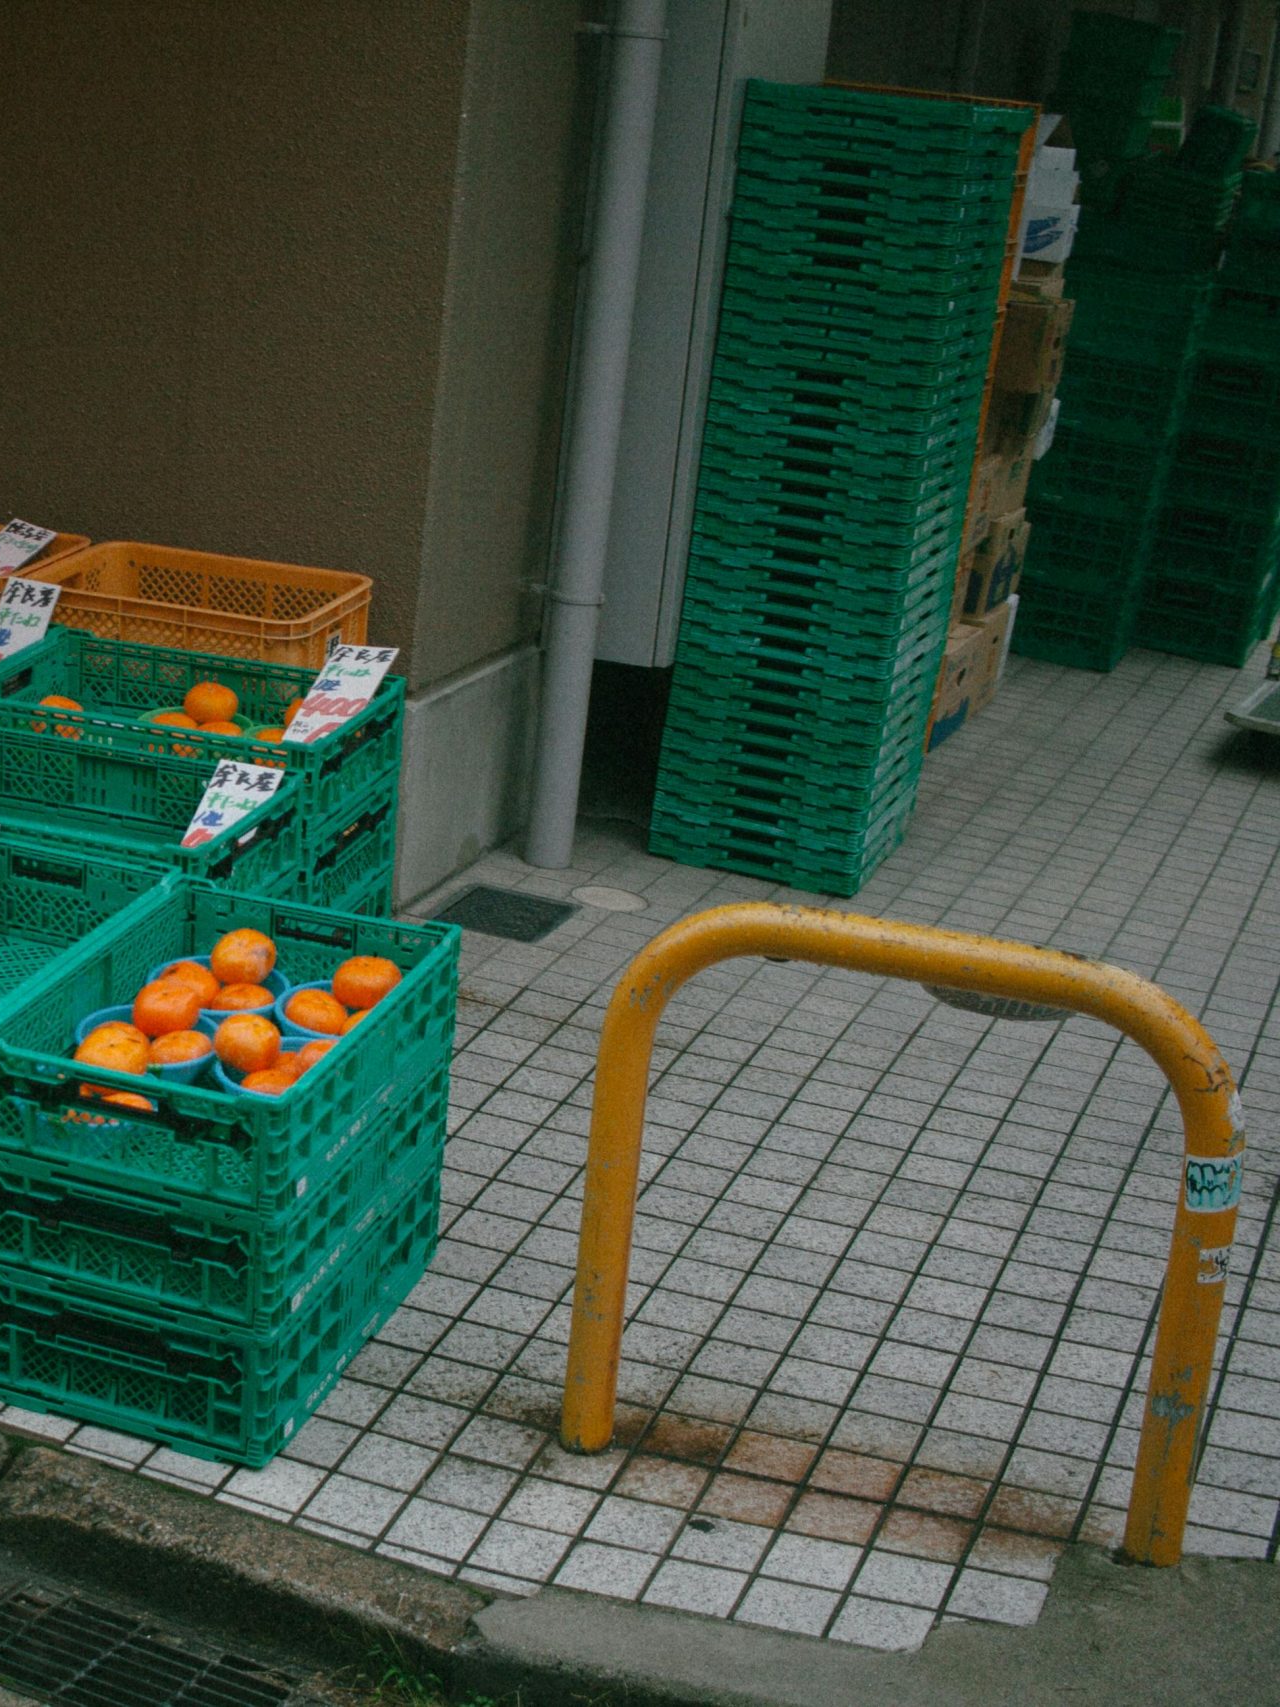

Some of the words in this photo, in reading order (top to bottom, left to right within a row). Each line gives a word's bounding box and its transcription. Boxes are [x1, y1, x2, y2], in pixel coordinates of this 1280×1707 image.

[301, 693, 369, 717] 400
[208, 764, 277, 792] 奈良産
